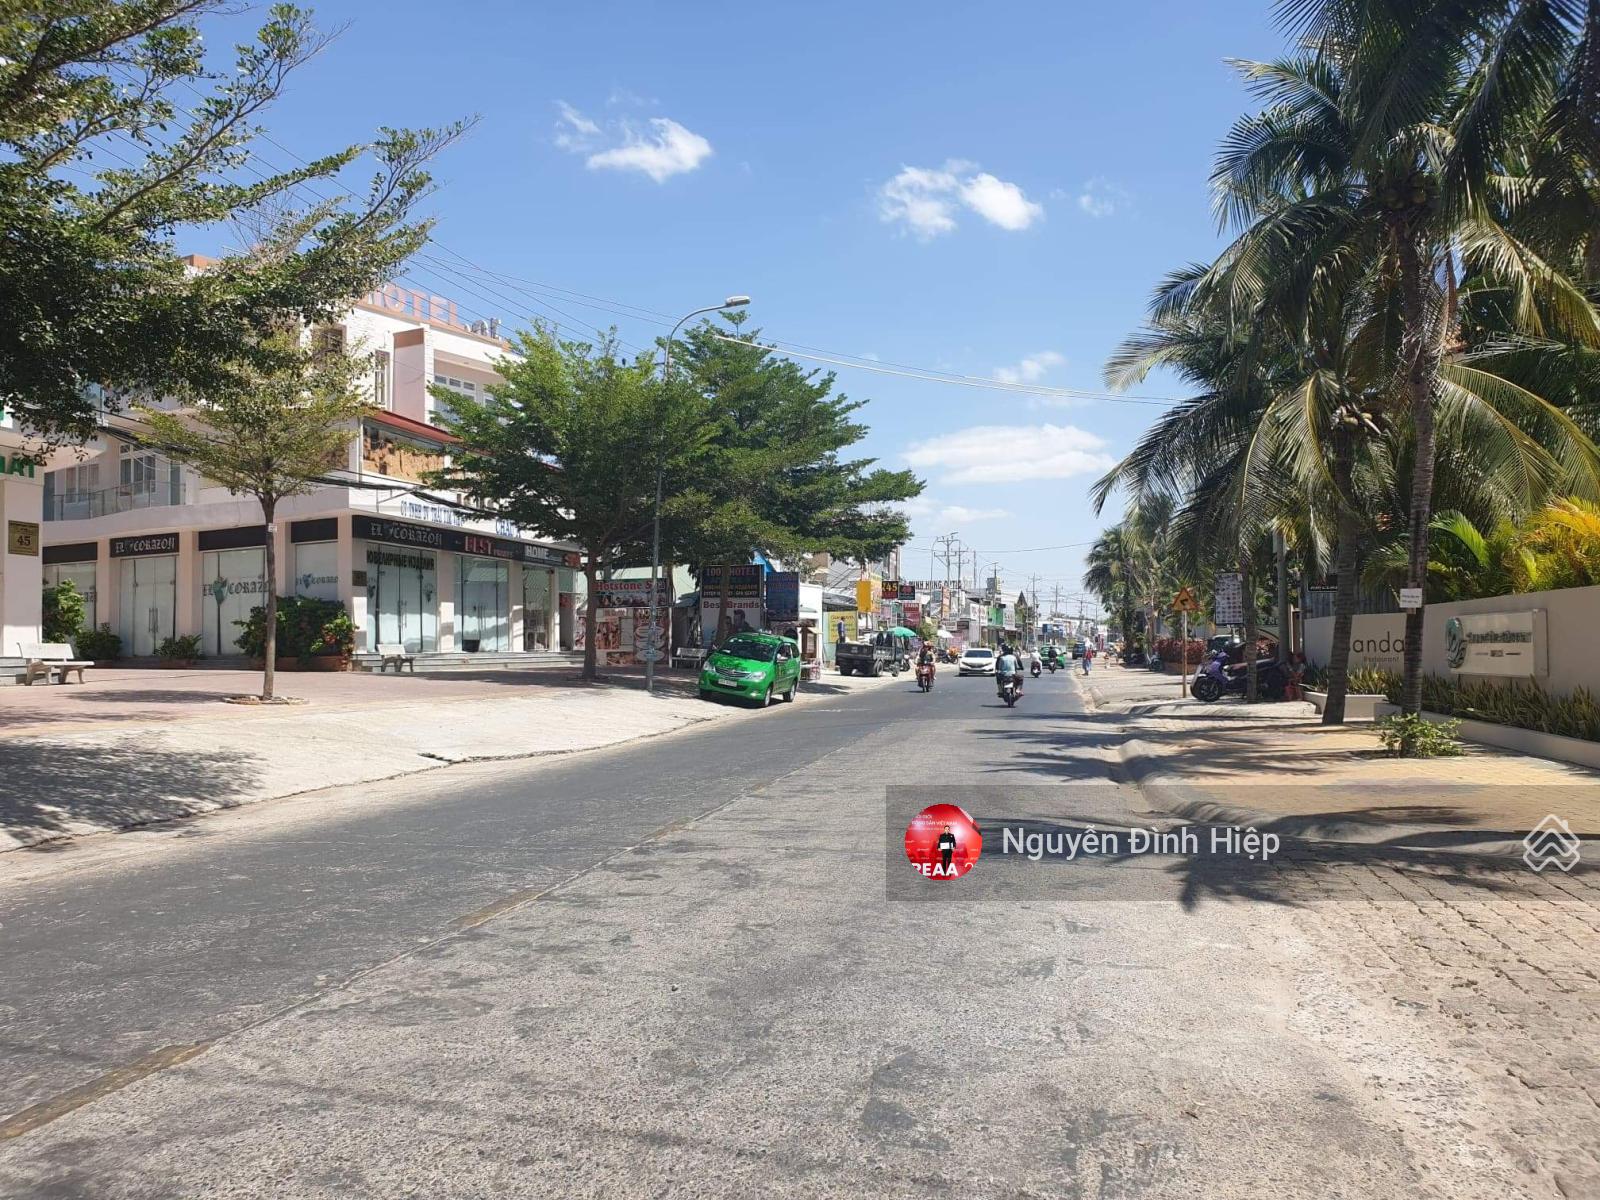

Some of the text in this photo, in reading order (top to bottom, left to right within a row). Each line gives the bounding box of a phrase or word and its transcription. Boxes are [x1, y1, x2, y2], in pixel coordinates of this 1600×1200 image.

[17, 535, 31, 547] 45
[229, 580, 271, 595] CORAZO
[1349, 631, 1405, 653] anda
